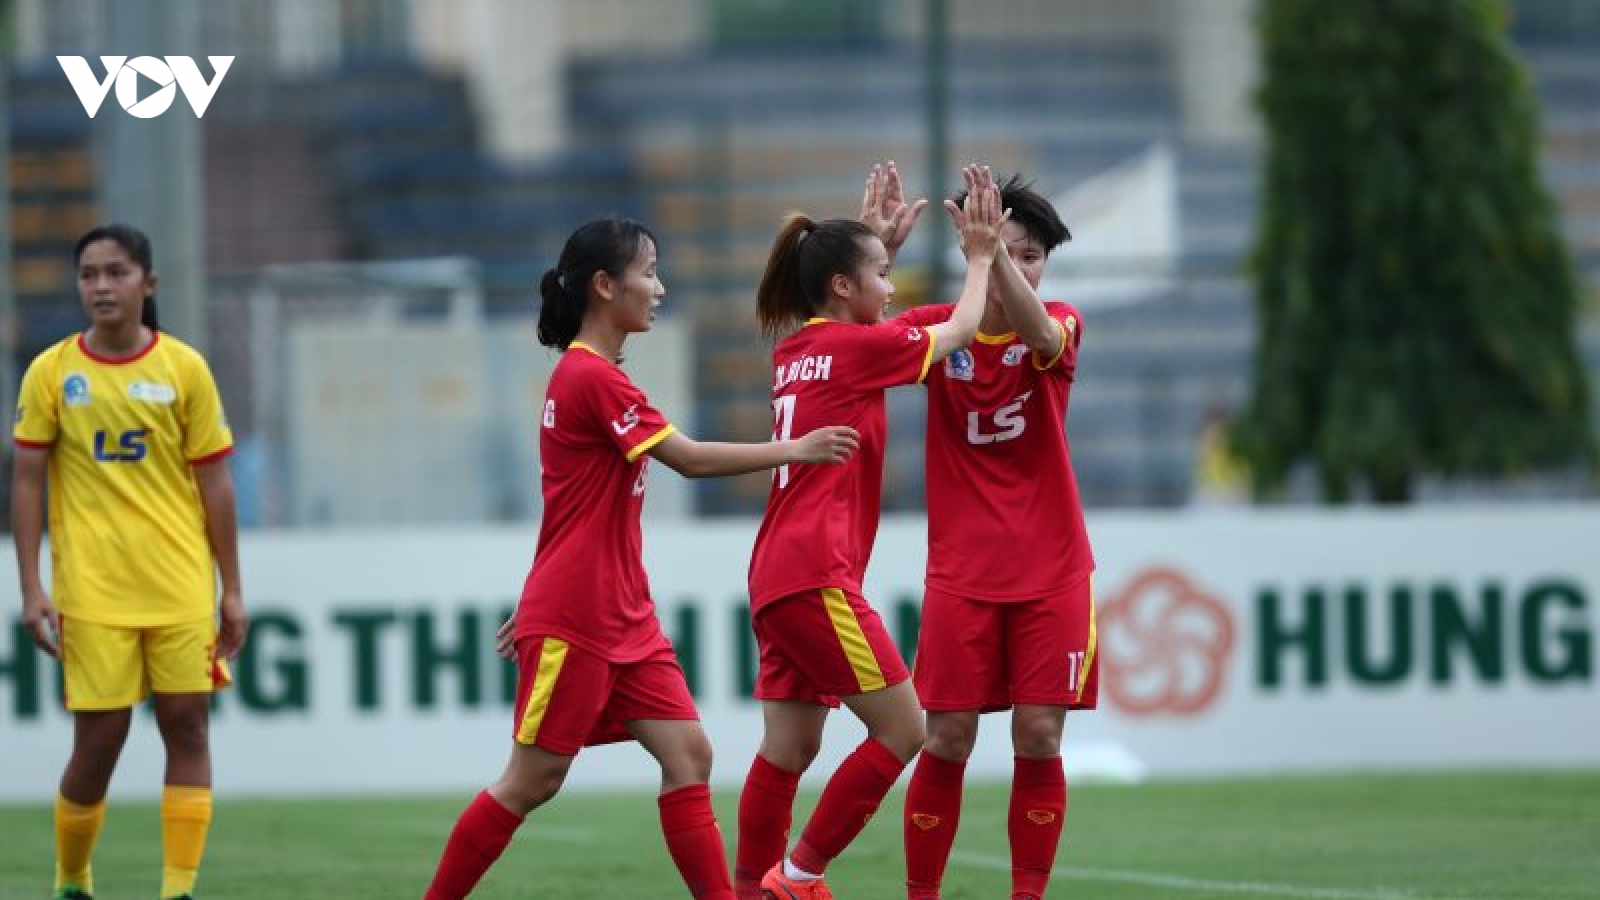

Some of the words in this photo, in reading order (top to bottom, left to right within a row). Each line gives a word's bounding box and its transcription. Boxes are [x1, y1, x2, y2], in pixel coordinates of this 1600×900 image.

[967, 390, 1032, 444] LS
[94, 428, 148, 461] LS
[1254, 578, 1596, 692] HUNG
